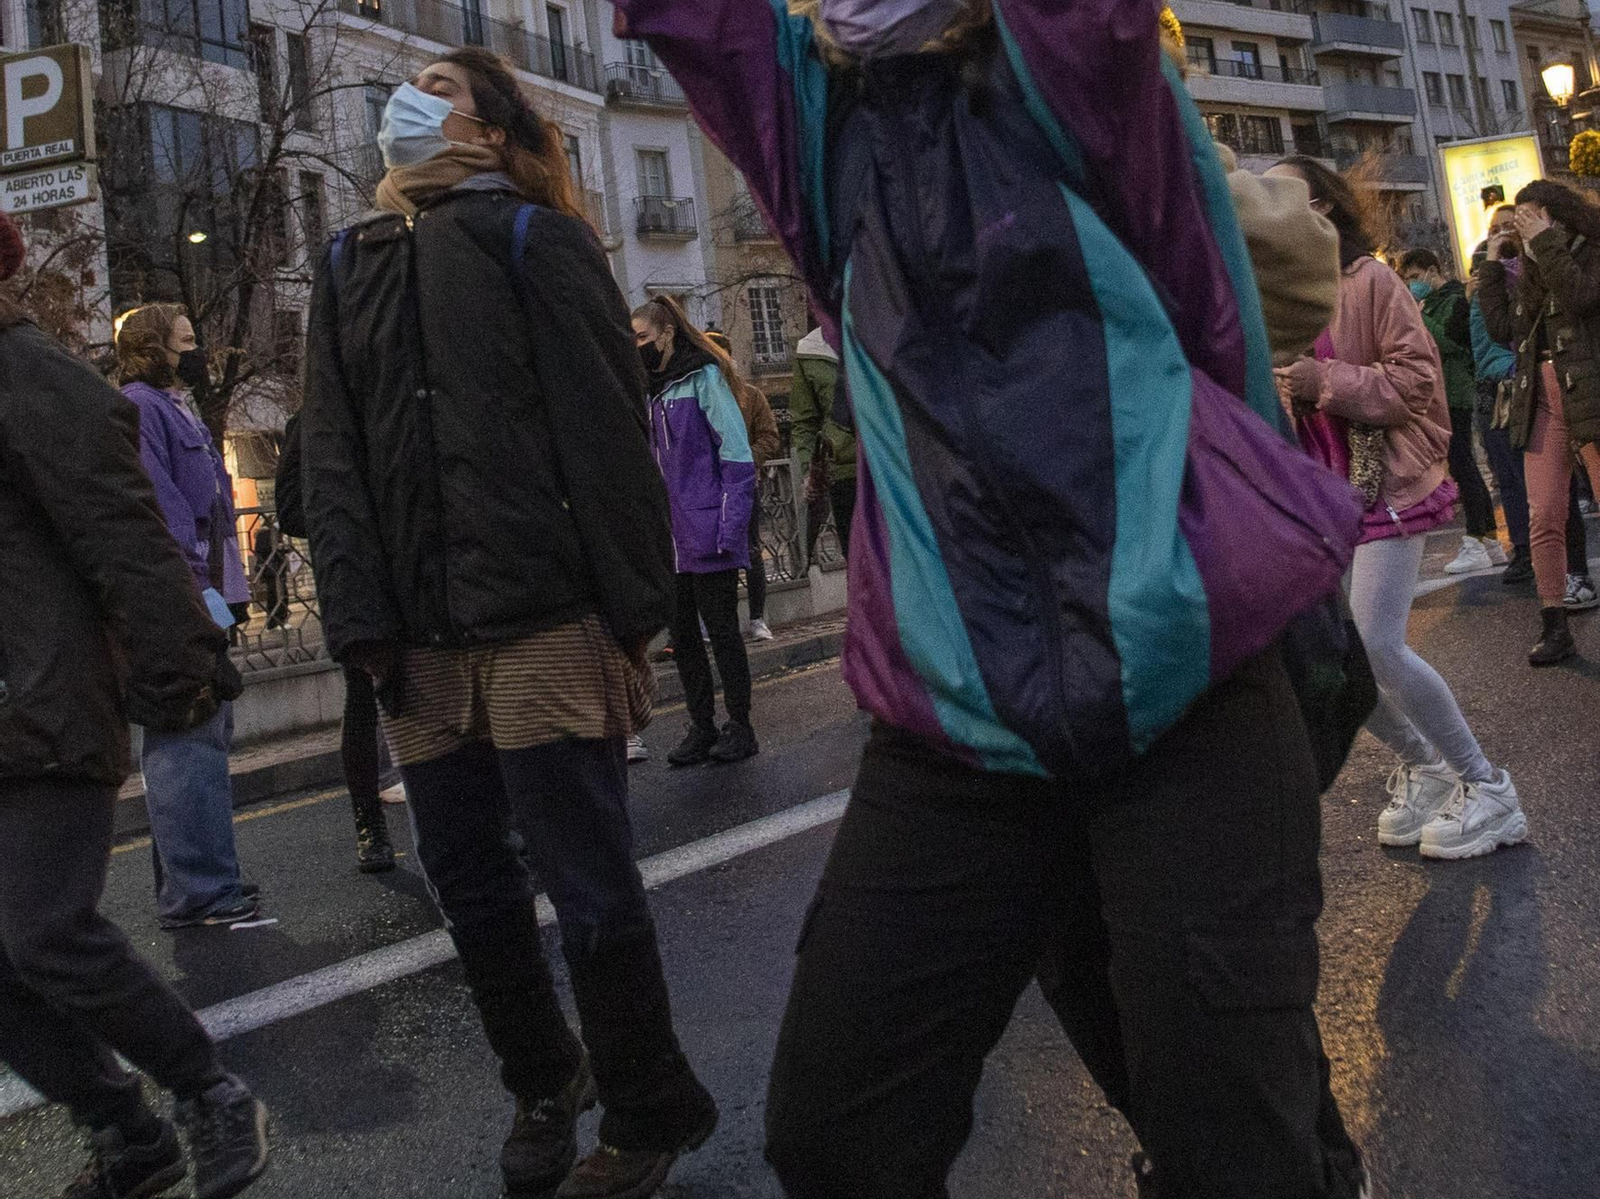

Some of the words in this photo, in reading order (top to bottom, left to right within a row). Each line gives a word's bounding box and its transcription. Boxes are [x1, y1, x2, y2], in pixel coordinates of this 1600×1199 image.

[4, 56, 63, 149] P
[4, 149, 42, 164] PUERTA
[45, 143, 71, 156] REAL
[5, 173, 55, 193] ABIERTO
[58, 167, 83, 184] LAS
[13, 195, 27, 208] 24
[32, 186, 75, 204] HORAS
